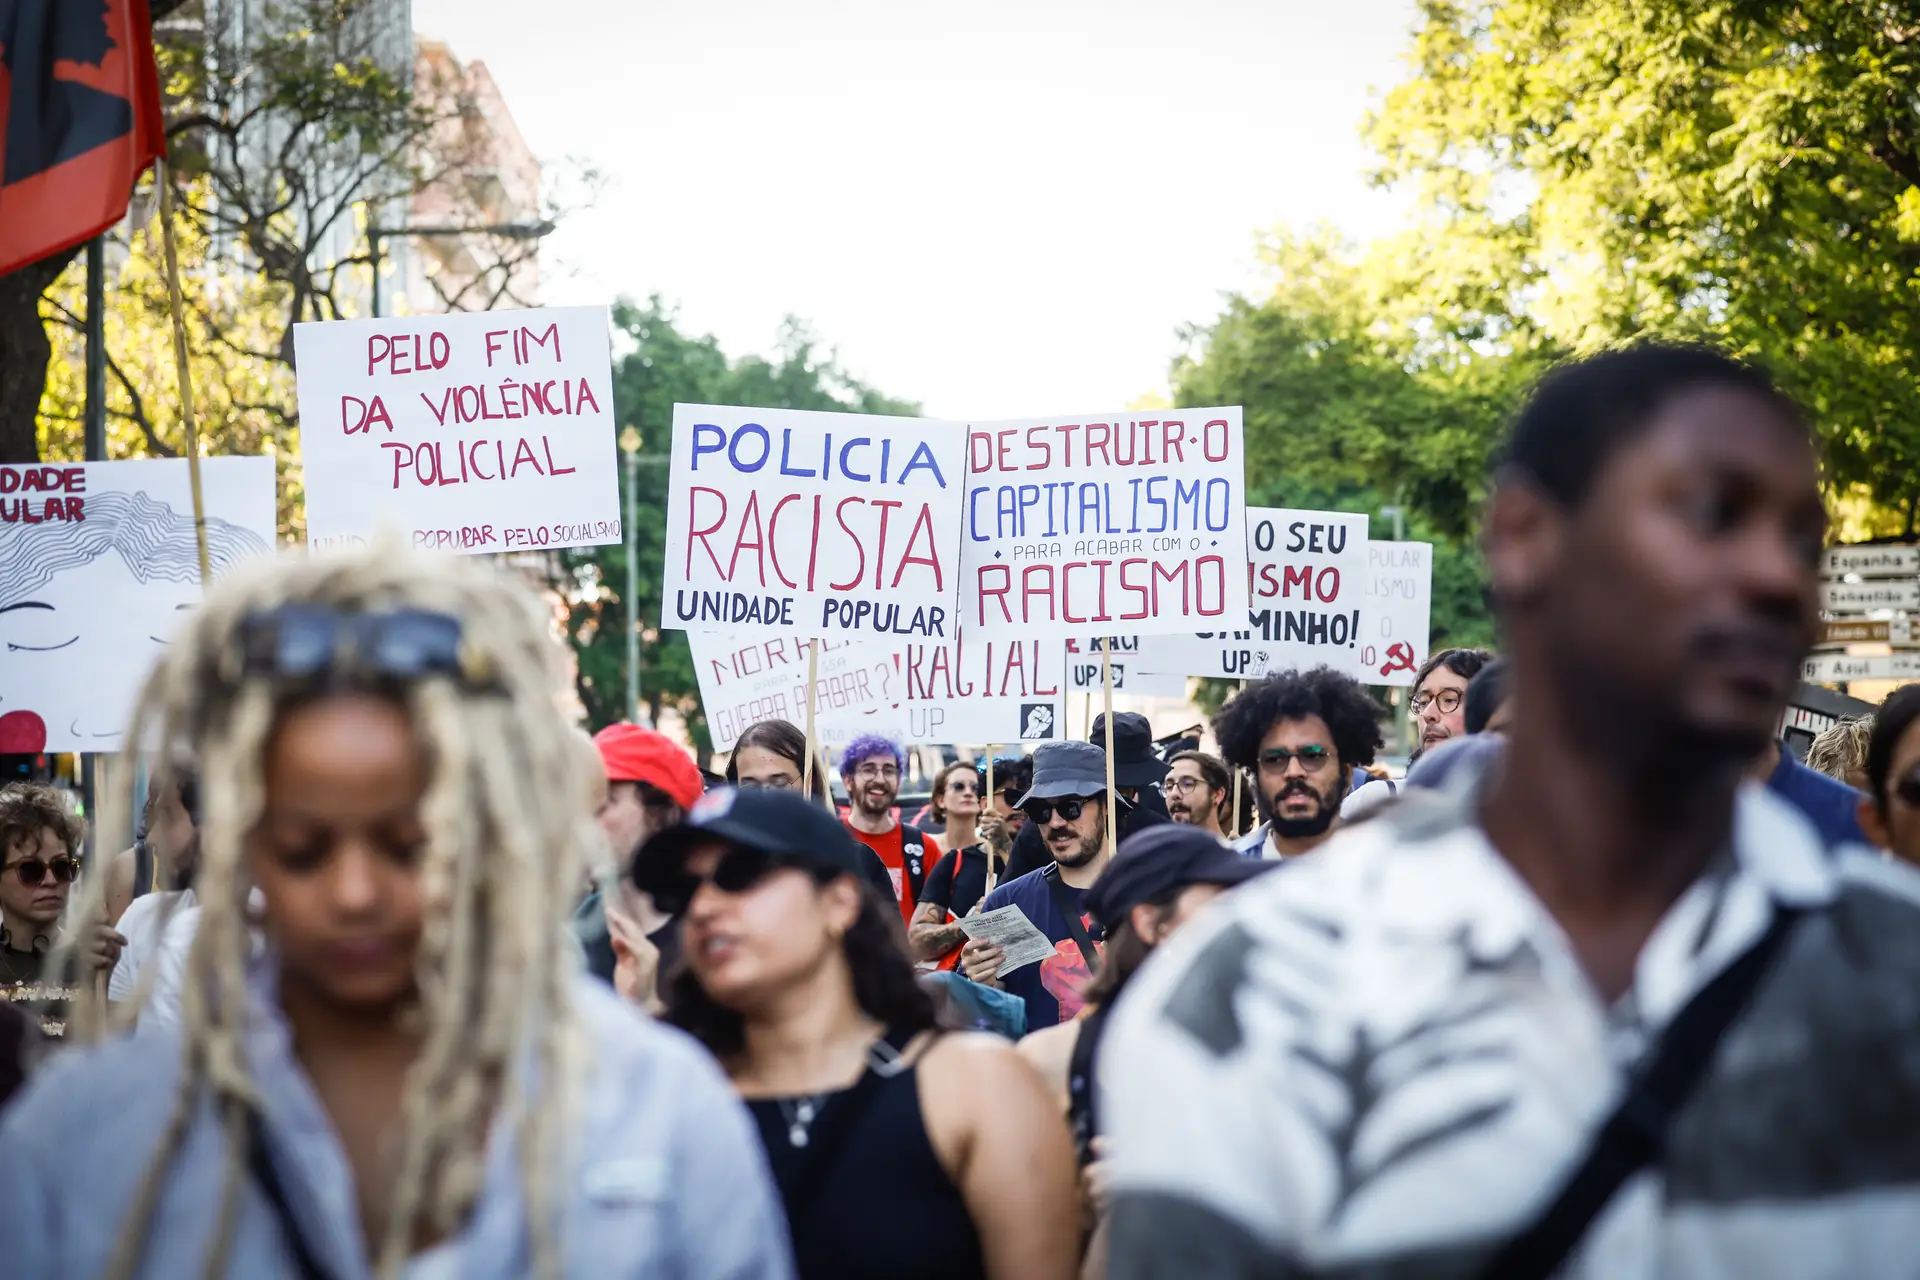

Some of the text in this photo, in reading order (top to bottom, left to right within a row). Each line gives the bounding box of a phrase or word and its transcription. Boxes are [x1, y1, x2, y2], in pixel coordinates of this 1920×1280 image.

[368, 323, 562, 376] PELO FIM
[342, 377, 600, 434] DA VIOLÊNCIA
[381, 435, 576, 489] POLICIAL
[691, 423, 946, 488] POLICIA
[504, 526, 549, 548] PELO
[551, 520, 621, 543] SOCIALISMO
[970, 476, 1231, 542] CAPITALISMO
[686, 486, 944, 593] RACISTA
[1013, 537, 1201, 561] PARA ACABAR COM O
[1286, 522, 1347, 554] SEU
[677, 590, 945, 638] UNIDADE POPULAR
[977, 555, 1225, 627] RACISMO
[1074, 664, 1097, 687] UP
[1222, 650, 1251, 674] UP
[910, 707, 945, 738] UP
